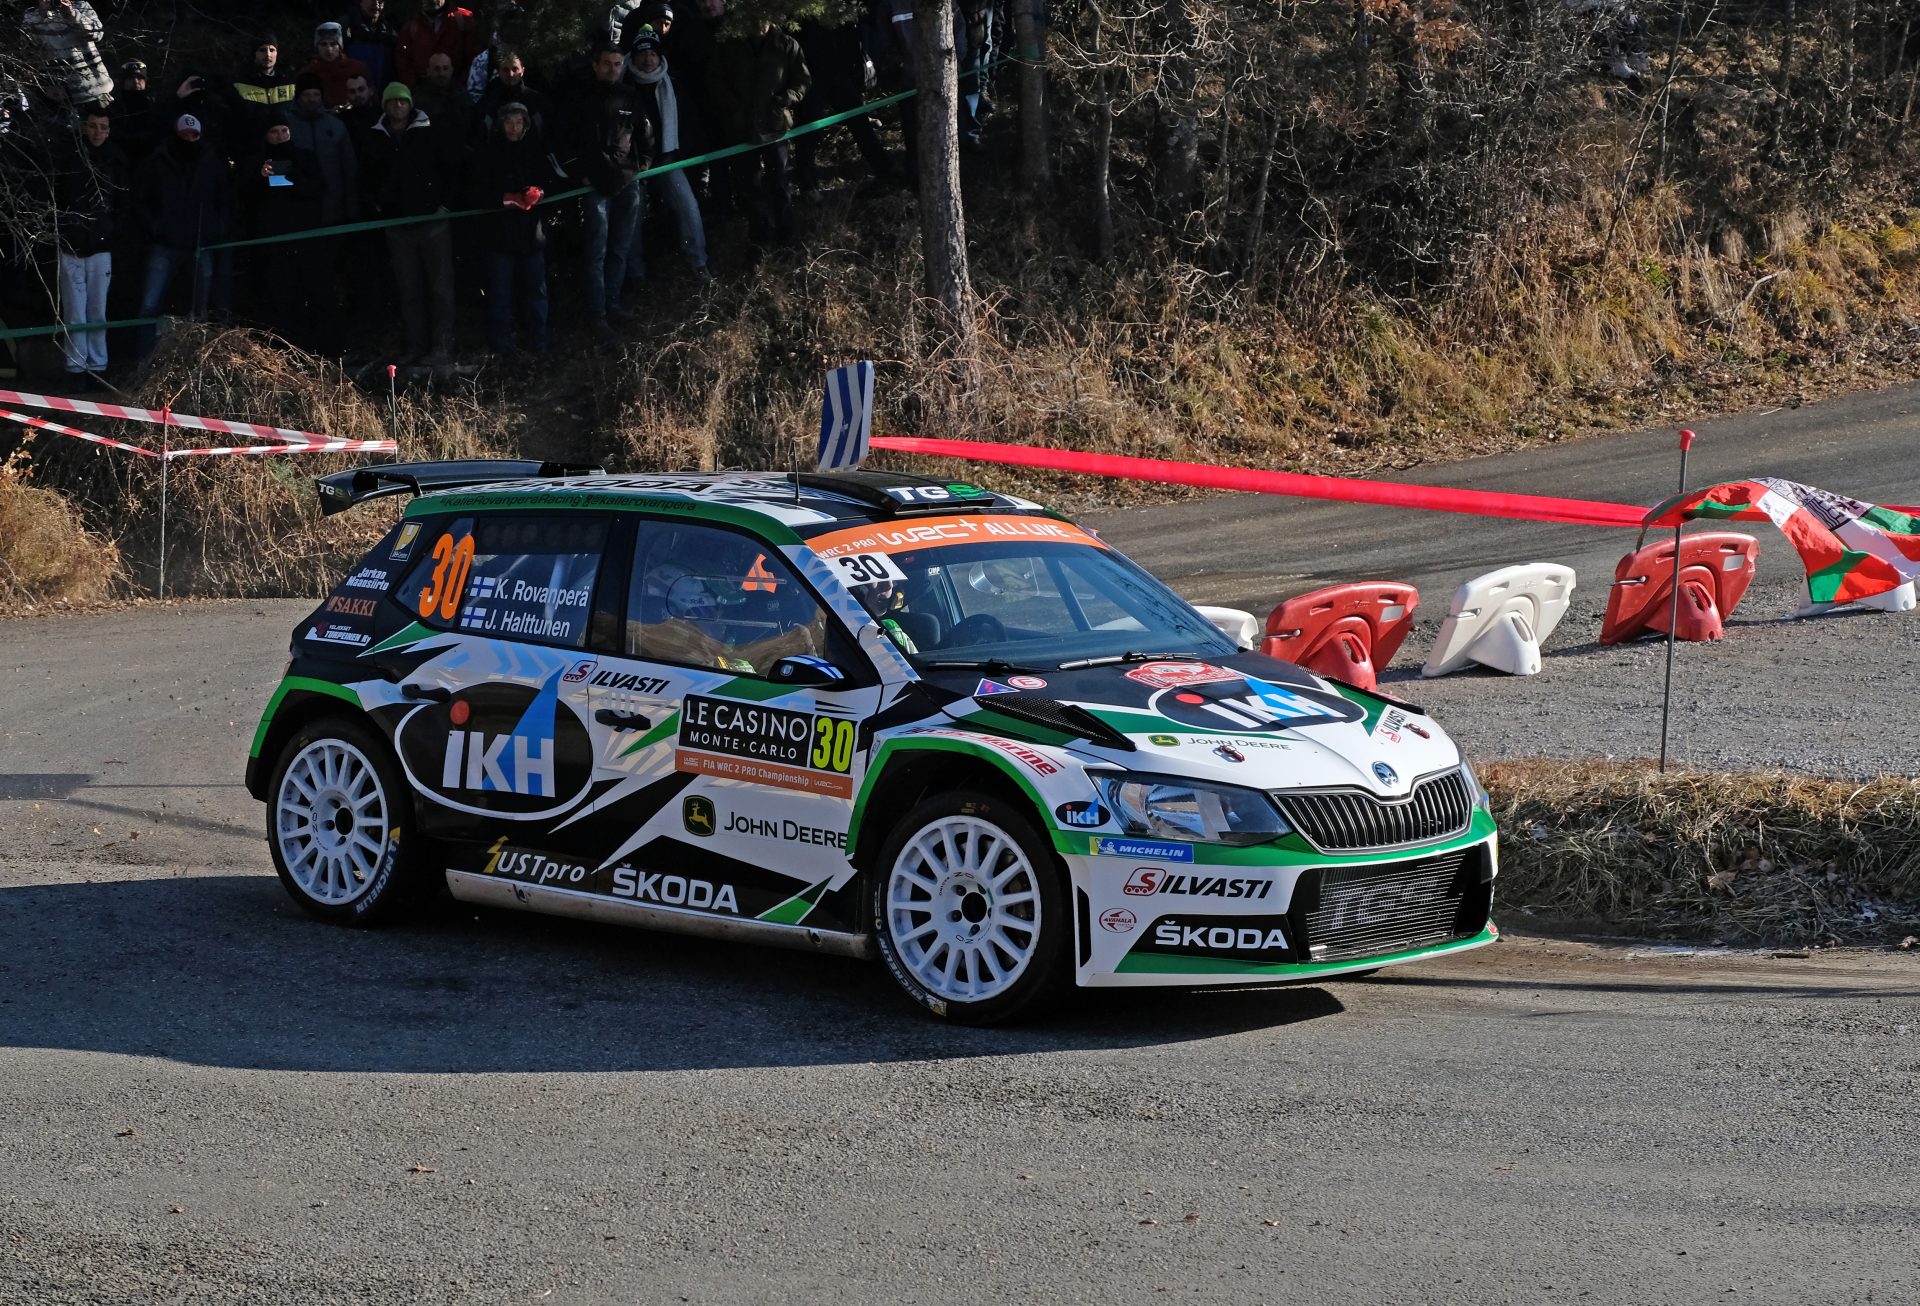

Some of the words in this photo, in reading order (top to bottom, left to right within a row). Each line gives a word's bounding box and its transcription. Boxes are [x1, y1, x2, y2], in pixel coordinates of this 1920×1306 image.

[885, 484, 985, 501] TGS
[852, 536, 878, 549] PRO
[983, 522, 1028, 536] ALL
[1019, 522, 1071, 538] LIVE
[357, 567, 387, 580] Jarkan
[418, 533, 475, 620] 30
[838, 554, 890, 582] 30
[345, 575, 391, 591] Maansiirto
[494, 578, 510, 600] K.
[511, 580, 590, 610] Rovanperä
[485, 609, 498, 630] J.
[500, 611, 570, 638] Halttunen
[686, 700, 709, 725] LE
[714, 705, 808, 742] CASINO
[812, 717, 854, 772] 30
[1231, 738, 1293, 751] DEERE
[703, 759, 715, 769] FIA
[716, 761, 733, 773] WRC
[734, 764, 741, 774] 2
[741, 766, 757, 777] PRO
[758, 768, 811, 787] Championship
[723, 811, 779, 838] JOHN
[782, 819, 848, 850] DEERE
[1118, 845, 1185, 857] MICHELIN
[612, 861, 739, 914] ŠKODA
[1154, 919, 1290, 950] ŠKODA
